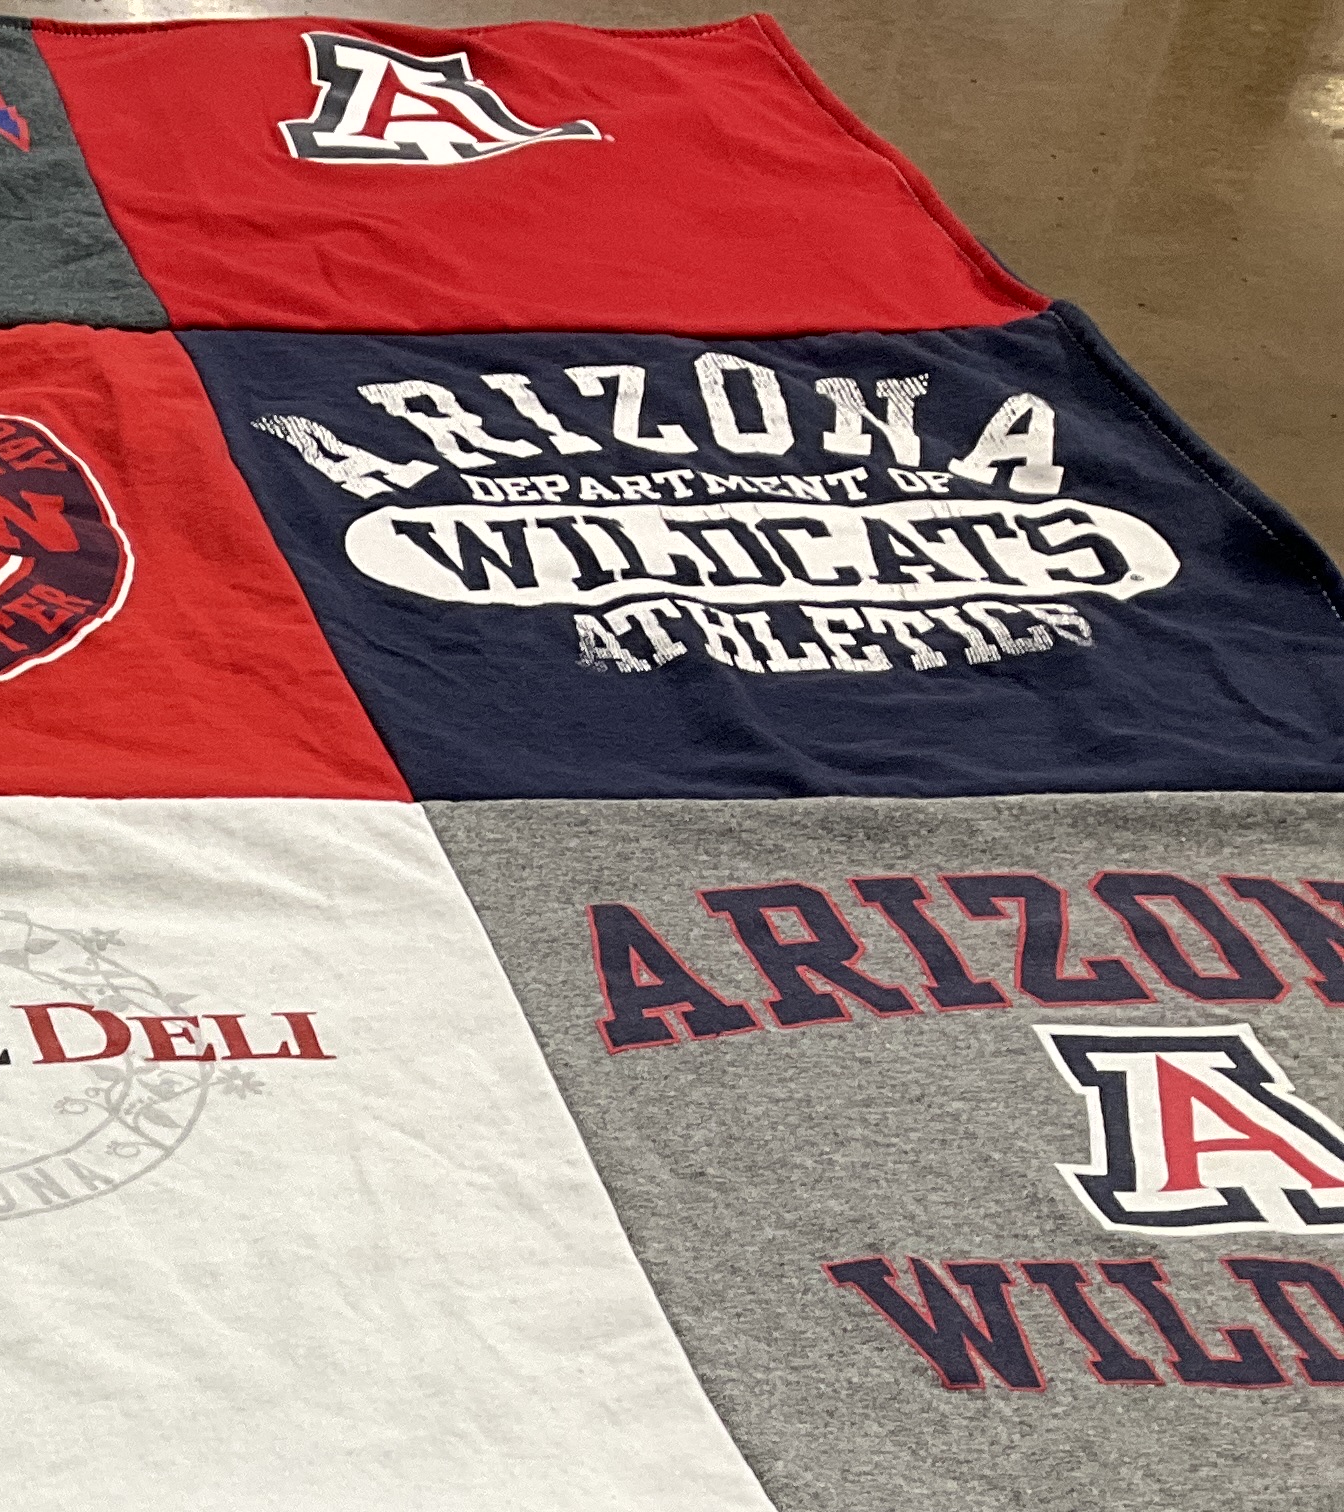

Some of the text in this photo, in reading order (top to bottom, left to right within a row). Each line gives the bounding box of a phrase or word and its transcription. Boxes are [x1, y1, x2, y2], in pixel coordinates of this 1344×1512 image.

[278, 31, 602, 166] A
[249, 351, 1066, 500] ARIZONA
[462, 467, 951, 503] DEPARTMENT OF
[392, 506, 1132, 594] WILDCATS
[574, 597, 1096, 676] ATHLETICS
[10, 1001, 339, 1065] DELI
[1032, 1023, 1344, 1236] A
